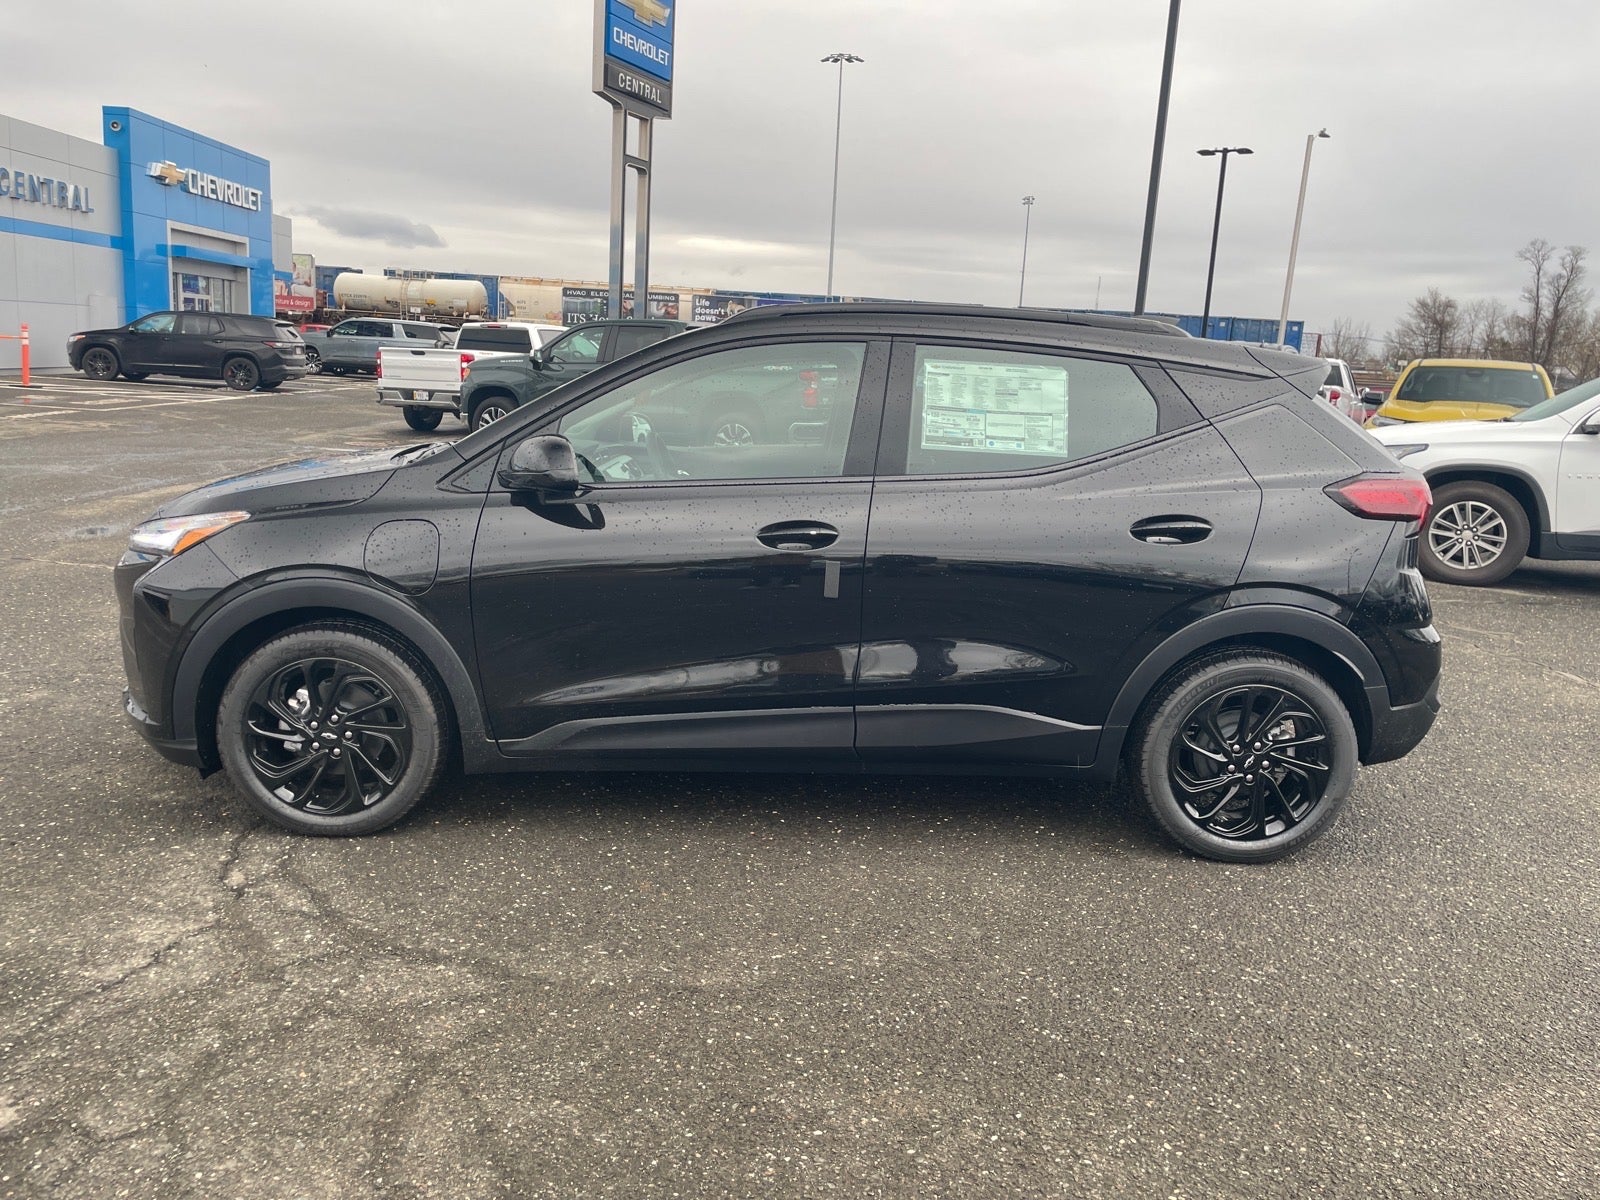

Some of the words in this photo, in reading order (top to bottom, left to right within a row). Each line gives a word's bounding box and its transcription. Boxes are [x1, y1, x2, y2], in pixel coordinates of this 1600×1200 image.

[613, 26, 670, 66] CHEVROLET
[618, 72, 662, 104] CENTRAL
[0, 167, 95, 213] CENTRAL
[186, 168, 263, 212] CHEVROLET
[695, 298, 710, 307] Life
[695, 306, 725, 315] doesn't
[567, 312, 587, 324] ITS
[695, 314, 717, 323] paws
